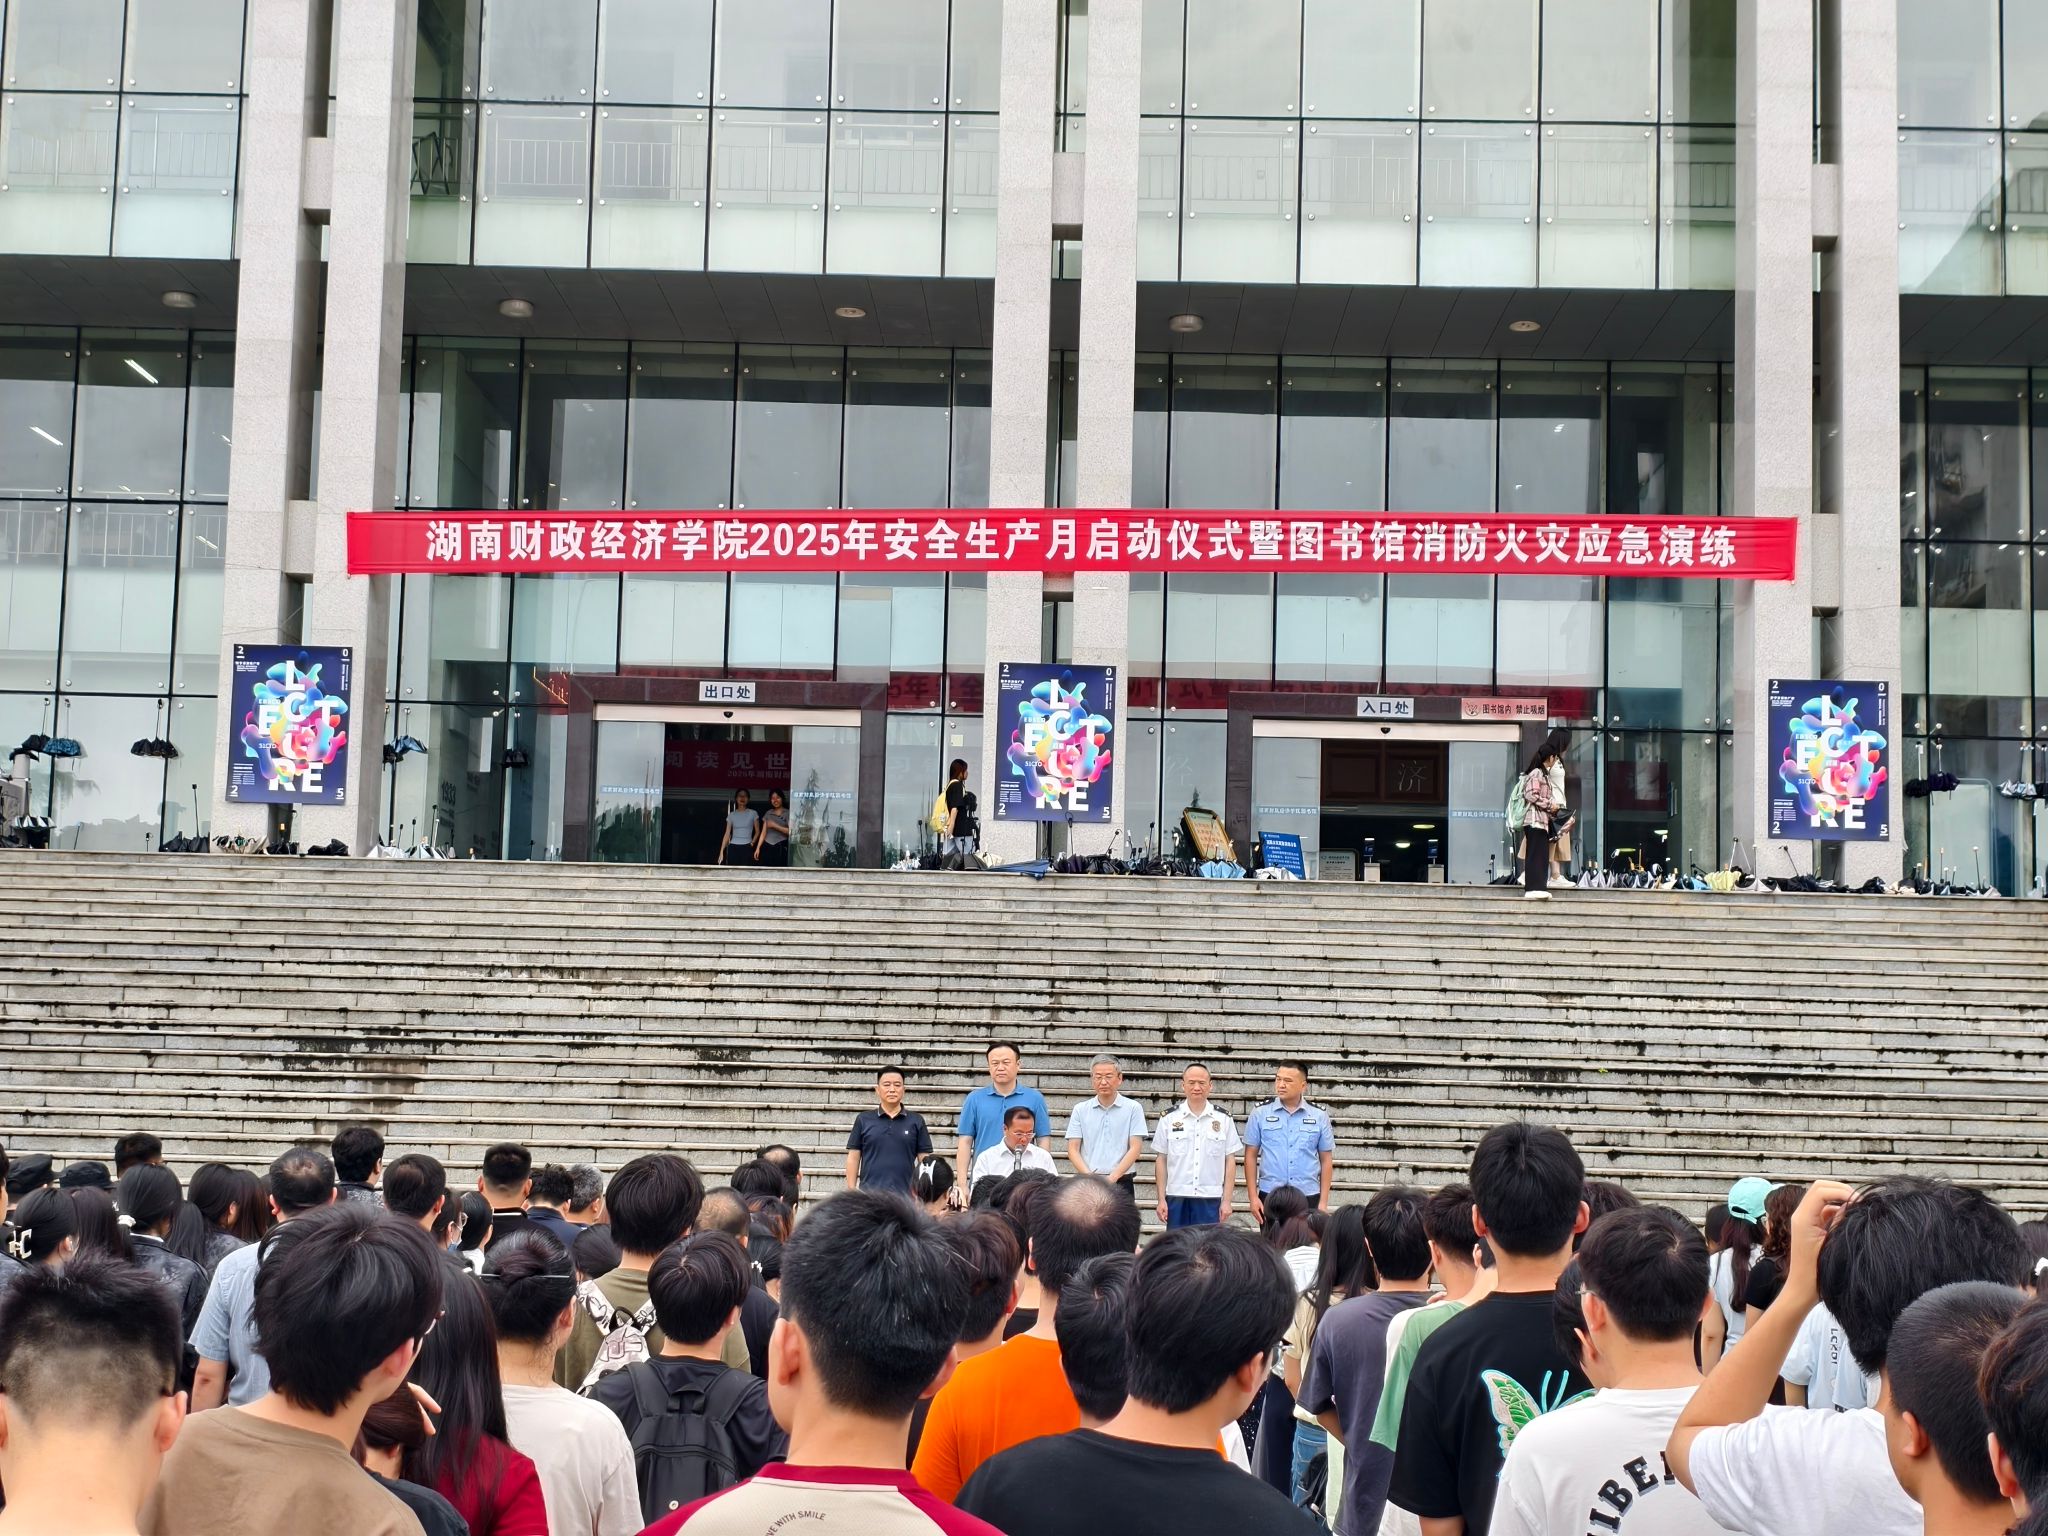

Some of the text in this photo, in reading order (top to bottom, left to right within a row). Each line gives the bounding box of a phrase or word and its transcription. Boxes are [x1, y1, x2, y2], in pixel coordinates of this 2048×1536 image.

[426, 519, 1736, 569] 湖南财政经济学院2025年安全生产月启动仪式暨图书馆消防火灾应急演练
[704, 686, 751, 700] 出口处
[1363, 700, 1410, 716] 入口处
[1482, 704, 1545, 715] 图书馆内 禁止吸烟
[774, 1512, 797, 1527] WITH
[797, 1510, 827, 1521] SMILE
